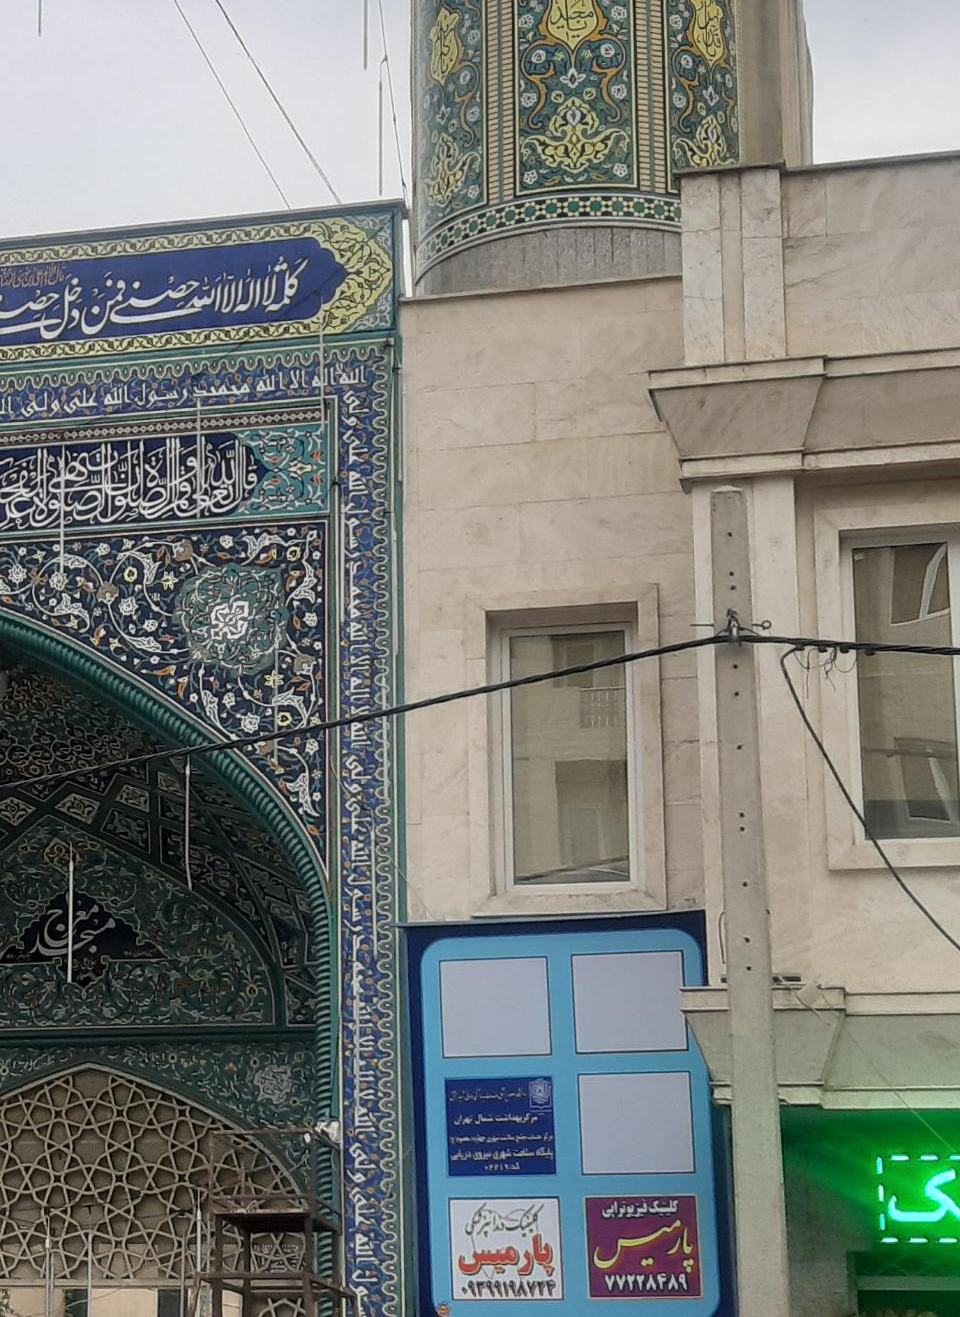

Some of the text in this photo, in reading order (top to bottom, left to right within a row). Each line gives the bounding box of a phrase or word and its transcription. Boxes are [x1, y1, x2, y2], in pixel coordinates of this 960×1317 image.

[193, 382, 251, 397] محمد
[256, 369, 287, 392] الله
[103, 382, 131, 406] الله
[134, 382, 188, 408] رسول
[602, 1200, 679, 1220] کلینیک فیزیوتراپی
[457, 1233, 555, 1277] پارمیس
[593, 1217, 694, 1274] پارمیس
